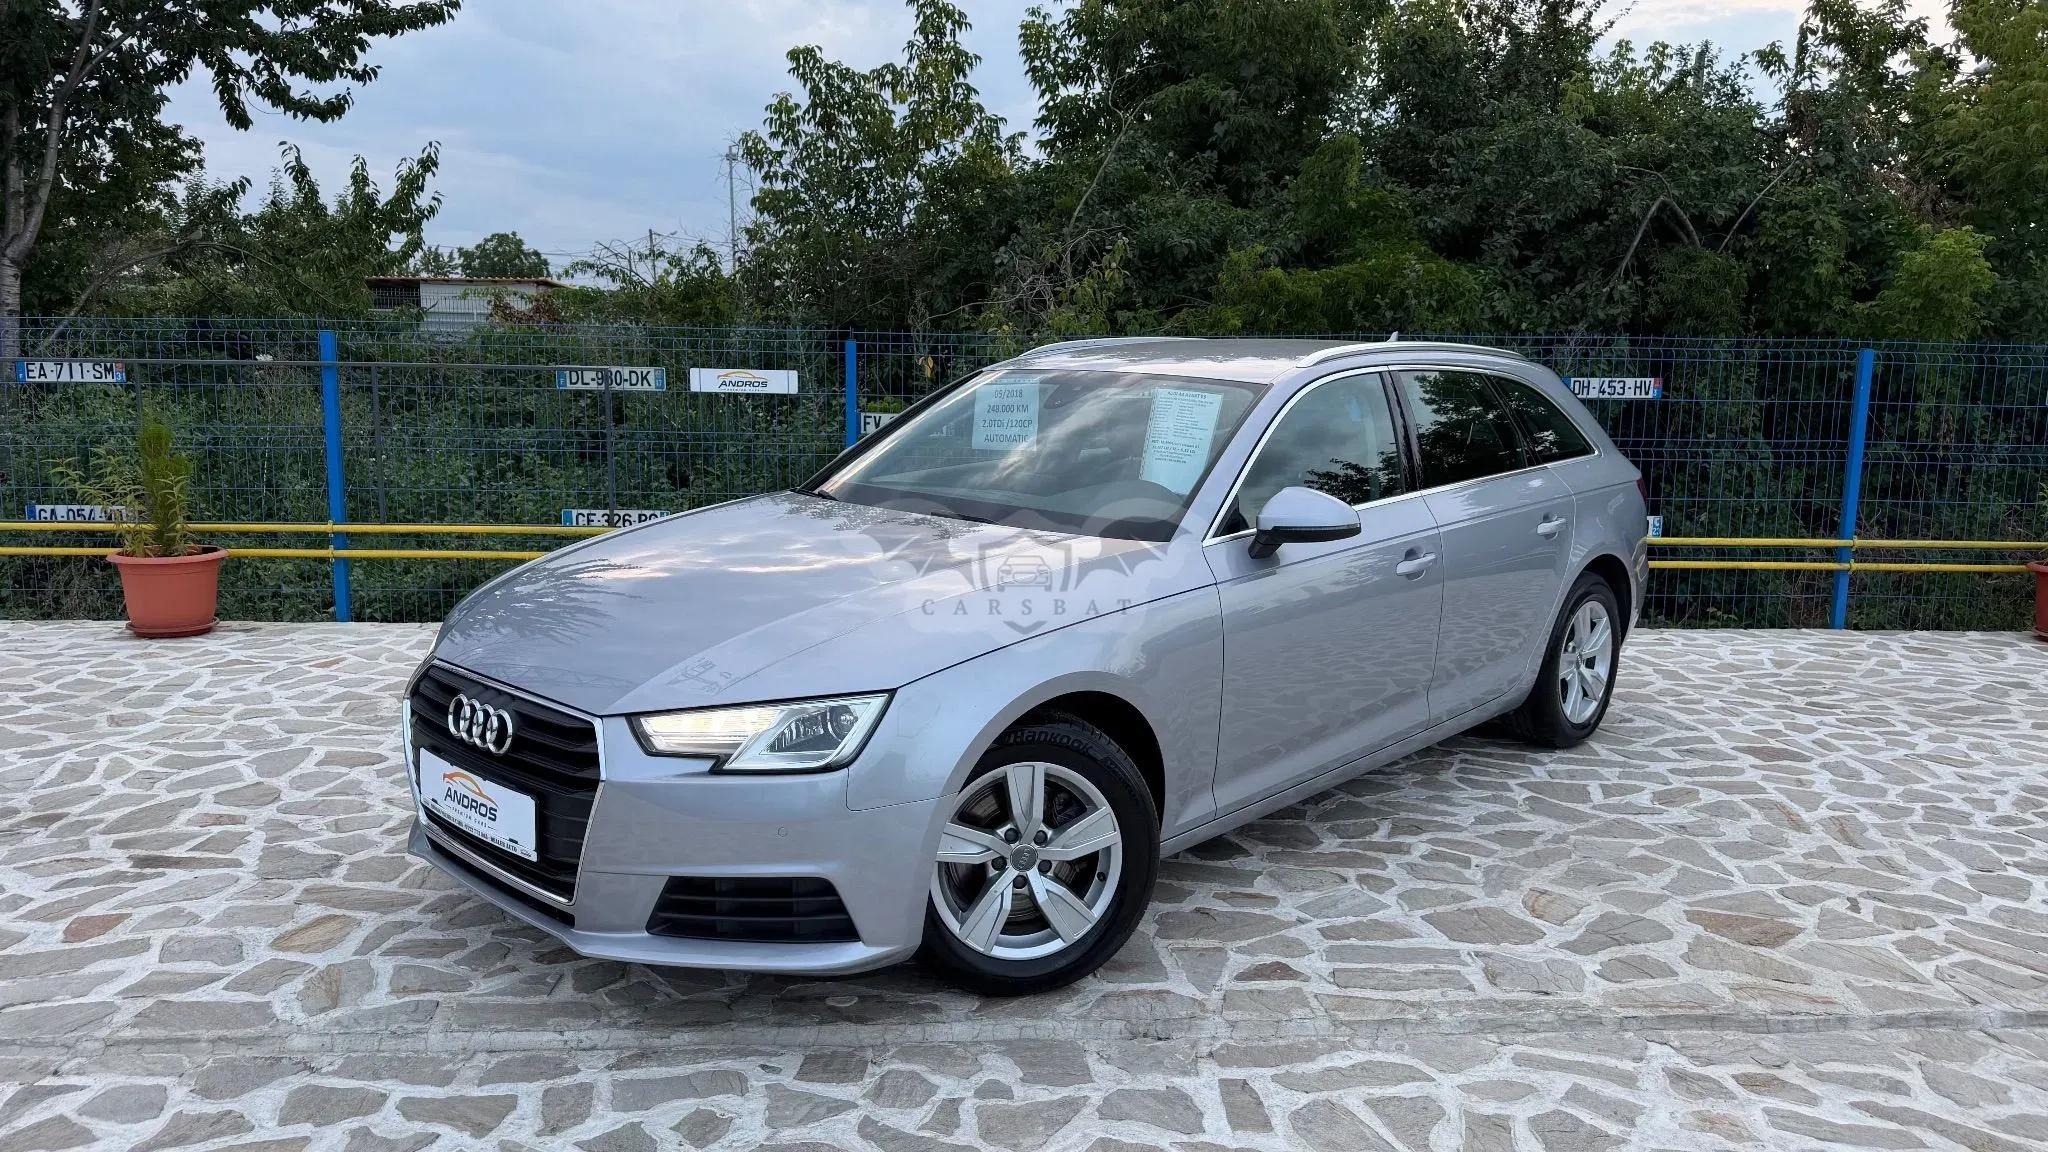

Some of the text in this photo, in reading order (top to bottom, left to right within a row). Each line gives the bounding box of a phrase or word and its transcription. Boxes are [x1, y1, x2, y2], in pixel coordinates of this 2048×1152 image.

[25, 362, 115, 380] EA-711-SM
[718, 380, 768, 389] ANDROS
[1573, 379, 1652, 396] DH-453-HV
[994, 388, 1023, 400] 05/2018
[987, 404, 1029, 413] 248.000 KM
[983, 433, 1029, 443] AUTOMATIC
[443, 786, 498, 823] ANDROS
